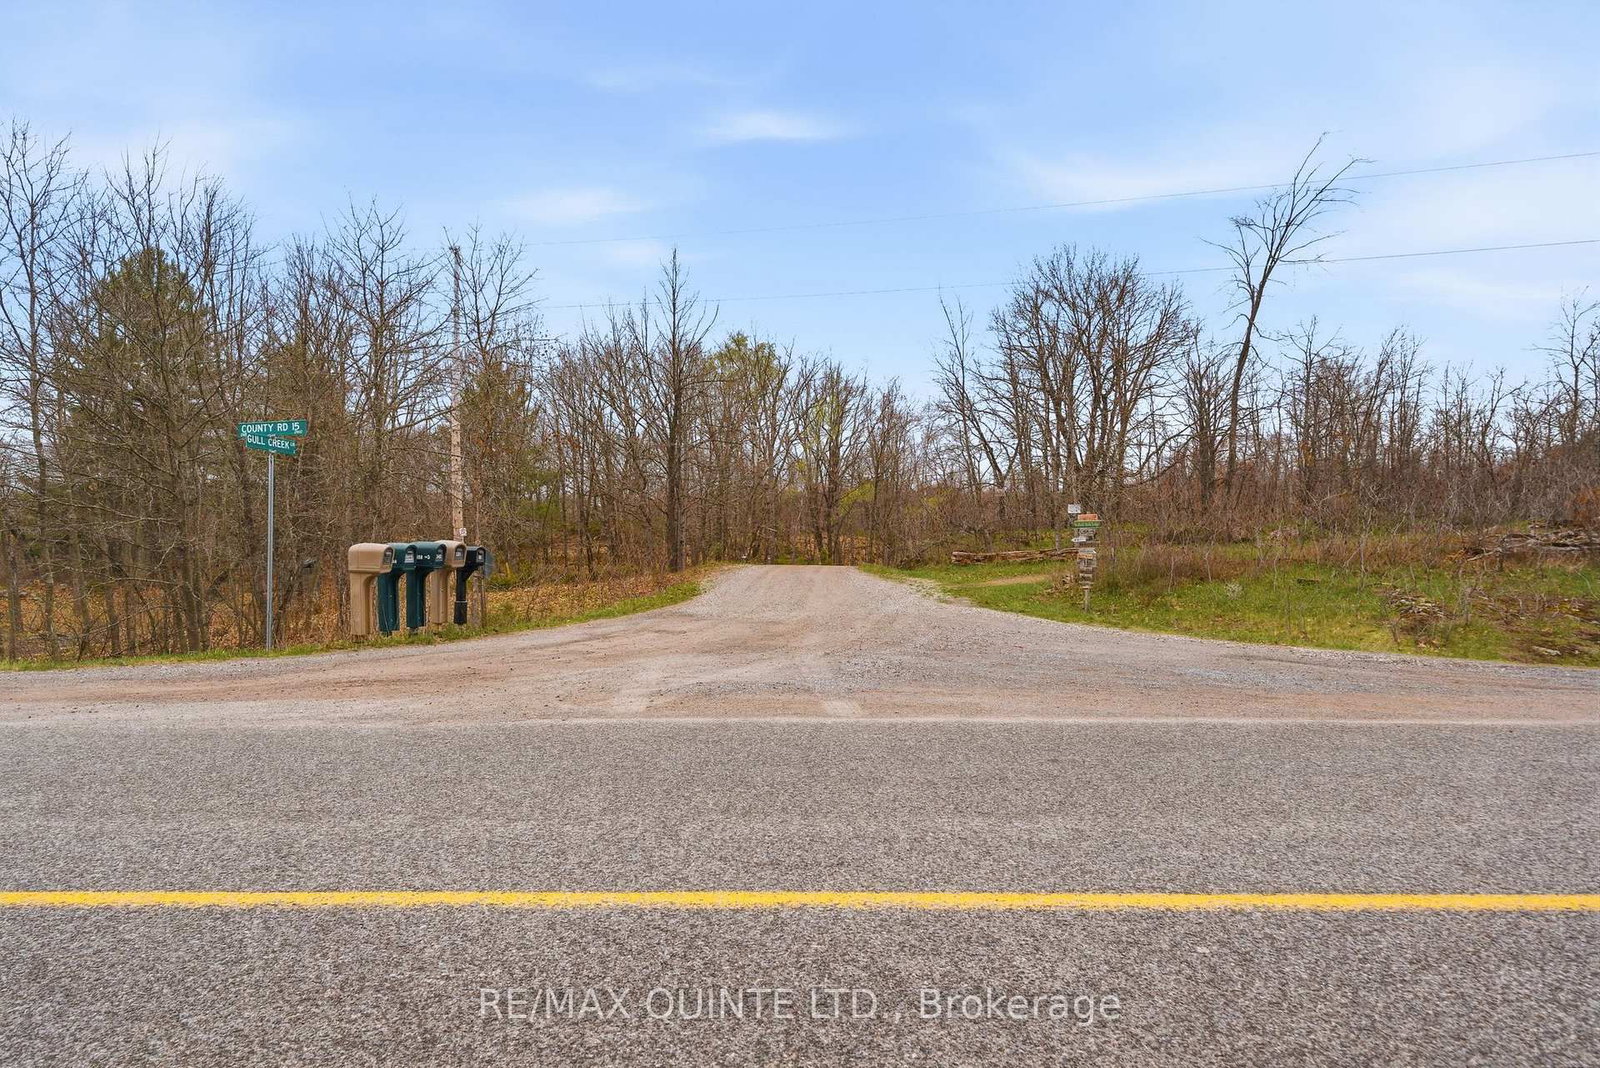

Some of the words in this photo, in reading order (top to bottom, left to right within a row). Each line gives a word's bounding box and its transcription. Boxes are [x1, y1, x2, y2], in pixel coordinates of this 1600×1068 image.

[241, 423, 273, 433] COUNTY
[277, 422, 288, 432] RD
[291, 422, 300, 431] 15
[247, 434, 265, 445] GULL
[267, 438, 290, 449] CREEK
